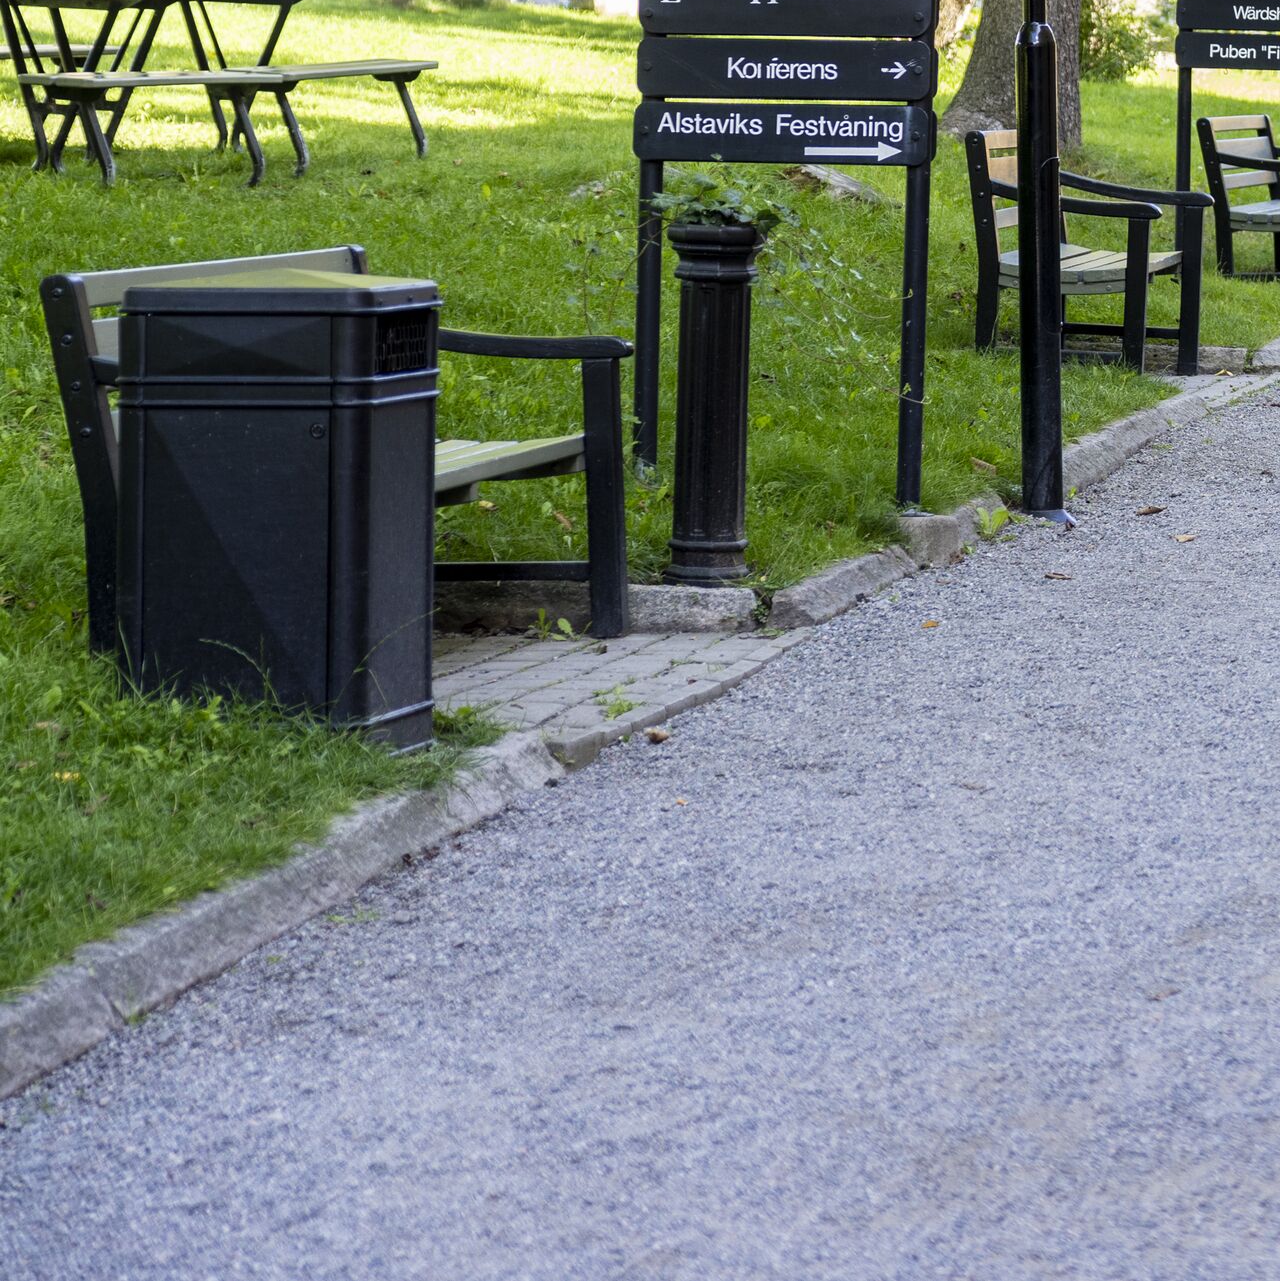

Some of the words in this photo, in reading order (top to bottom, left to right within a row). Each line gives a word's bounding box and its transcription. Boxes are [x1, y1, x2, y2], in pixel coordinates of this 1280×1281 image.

[1209, 43, 1257, 60] Puben
[727, 56, 838, 80] Konferens
[656, 111, 763, 136] Alstaviks
[775, 113, 904, 143] Festvåning
